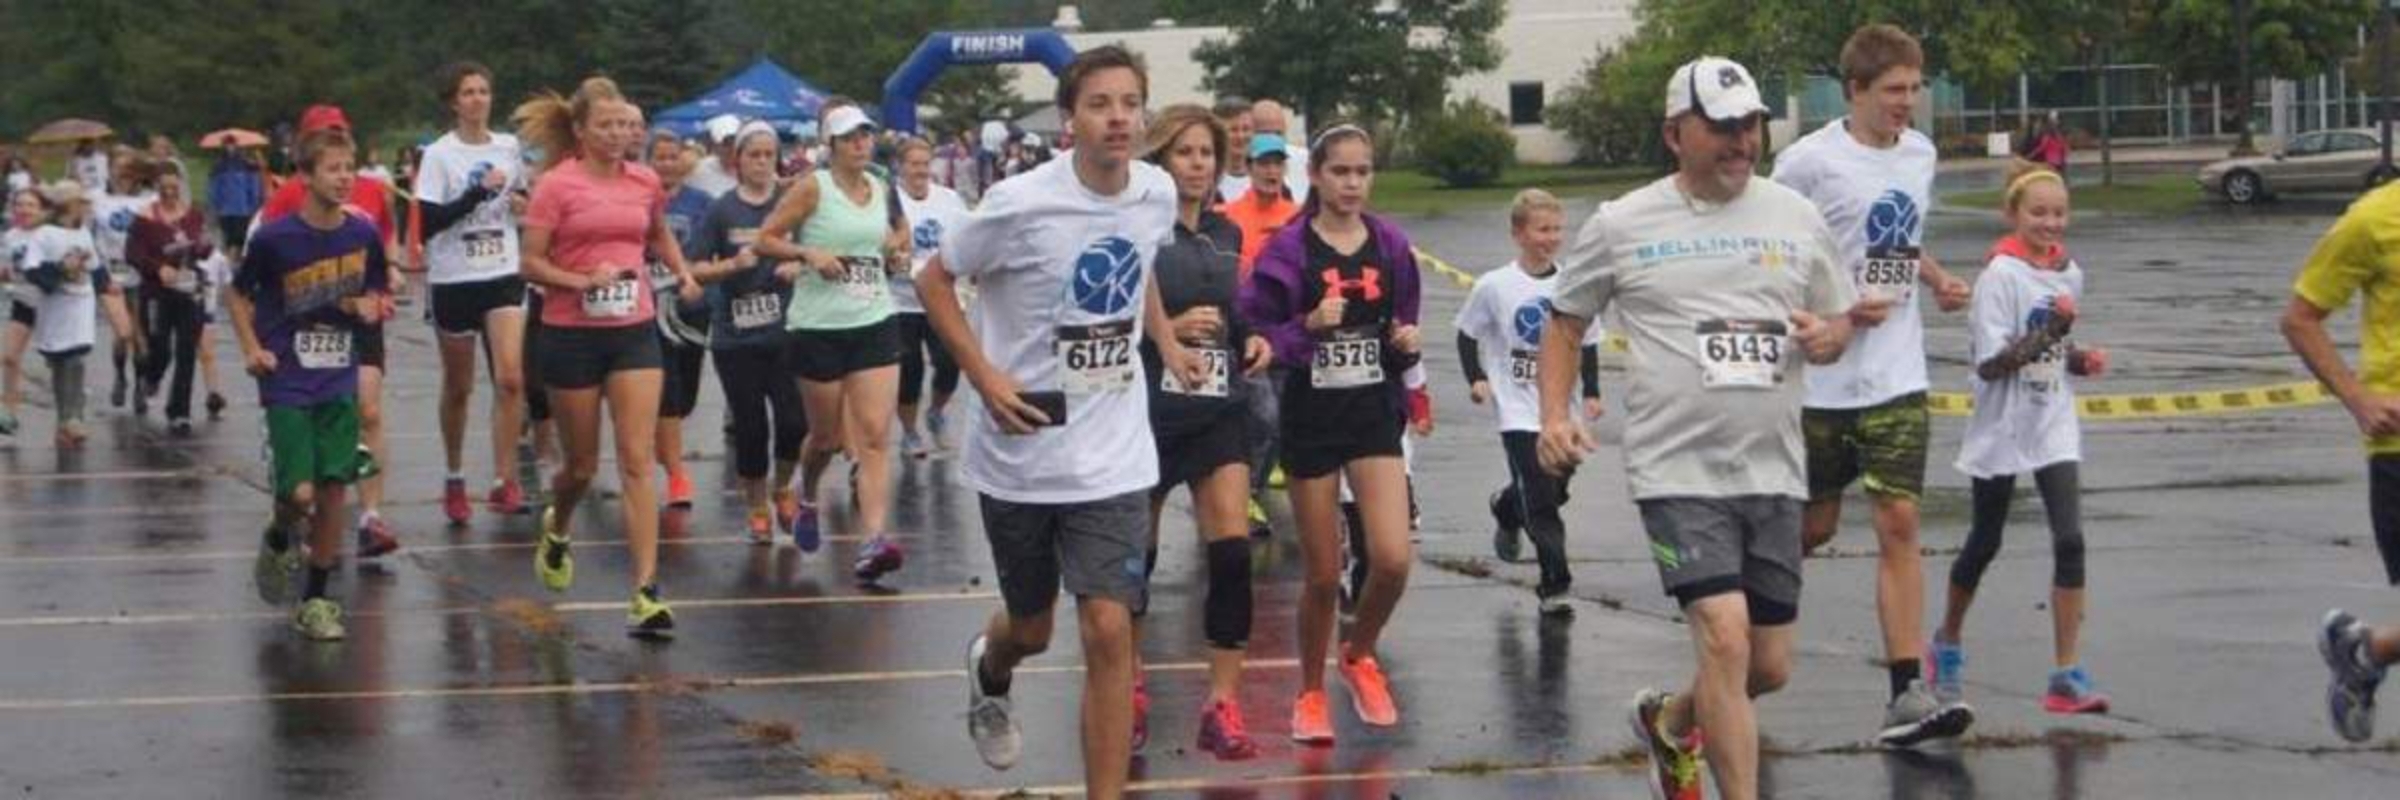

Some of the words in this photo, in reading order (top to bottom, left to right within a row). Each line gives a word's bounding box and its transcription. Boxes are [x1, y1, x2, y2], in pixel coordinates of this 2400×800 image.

[951, 34, 1025, 54] FINISH
[1066, 337, 1130, 371] 6172
[1317, 341, 1378, 367] 8578
[1706, 335, 1780, 364] 6143
